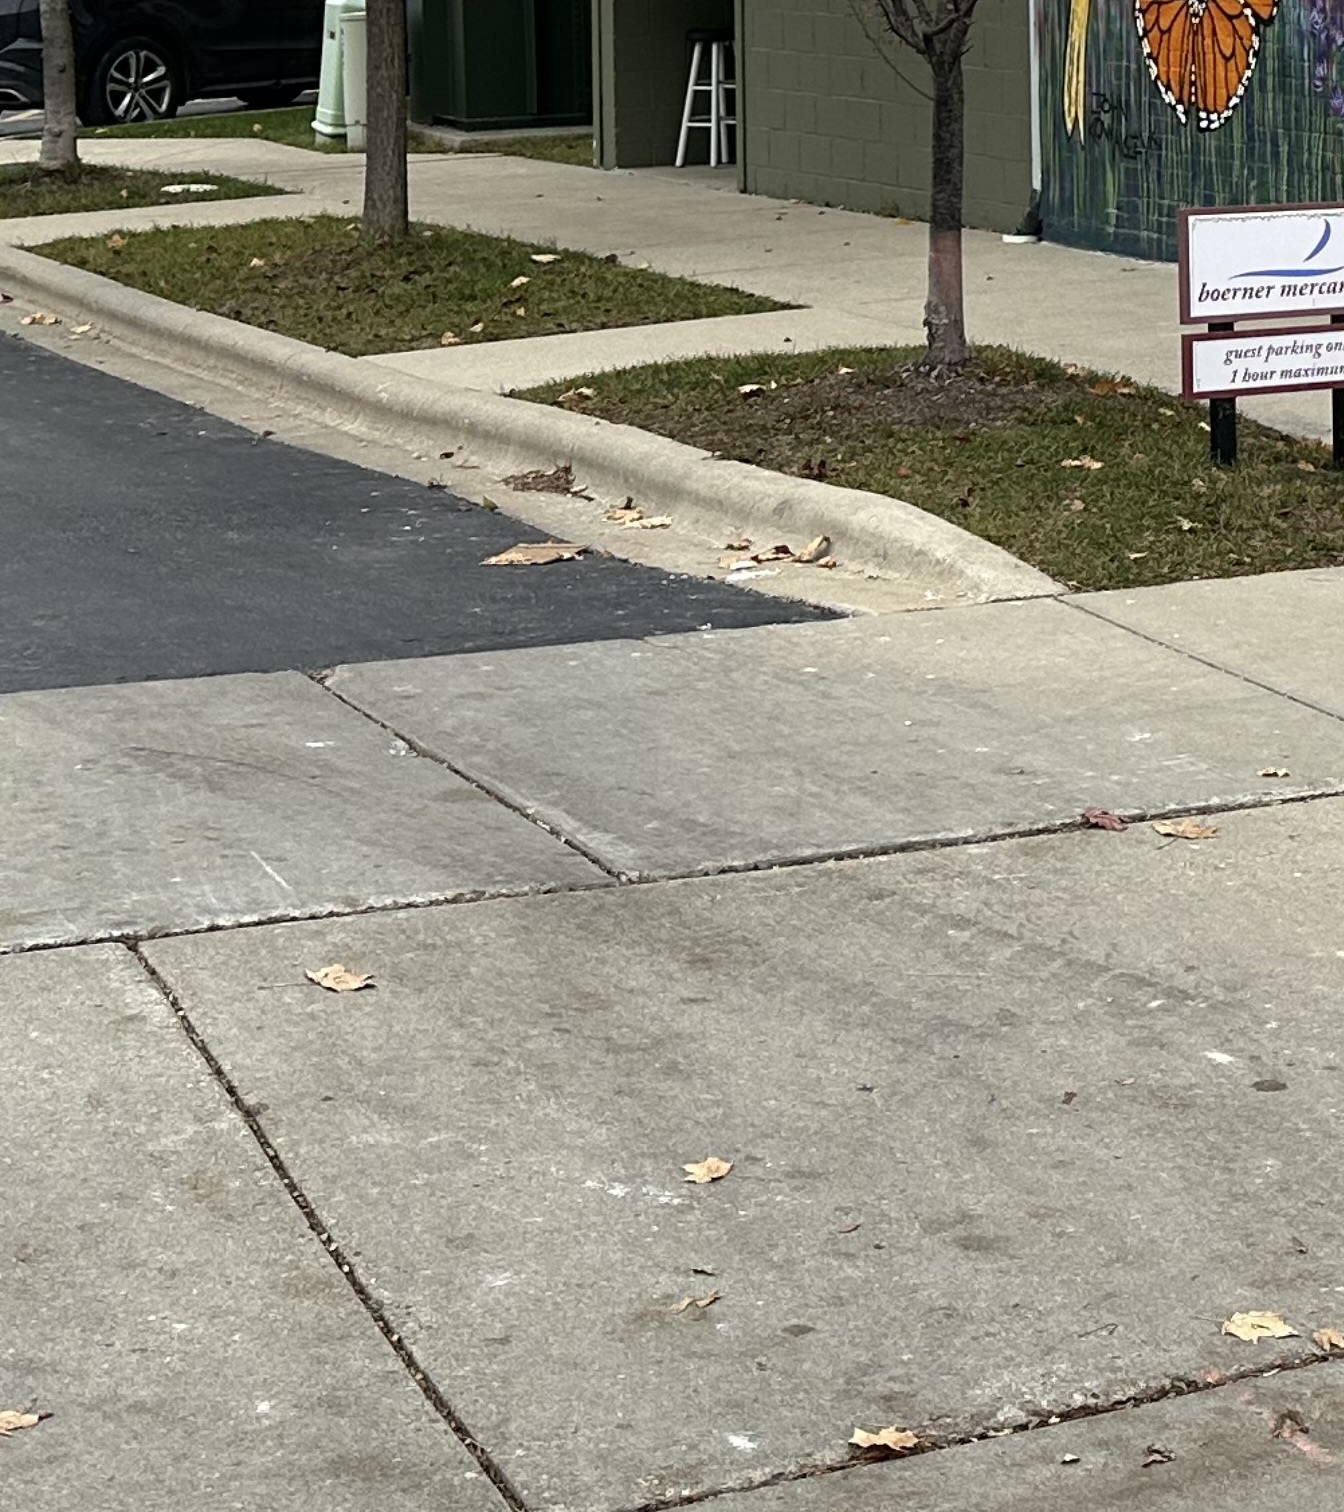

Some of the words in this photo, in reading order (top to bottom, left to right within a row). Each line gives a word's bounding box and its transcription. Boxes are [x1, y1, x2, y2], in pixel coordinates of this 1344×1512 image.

[1197, 282, 1276, 303] boerner
[1223, 344, 1262, 366] guest
[1264, 339, 1324, 363] parking
[1229, 369, 1239, 384] 1
[1242, 367, 1277, 383] hour
